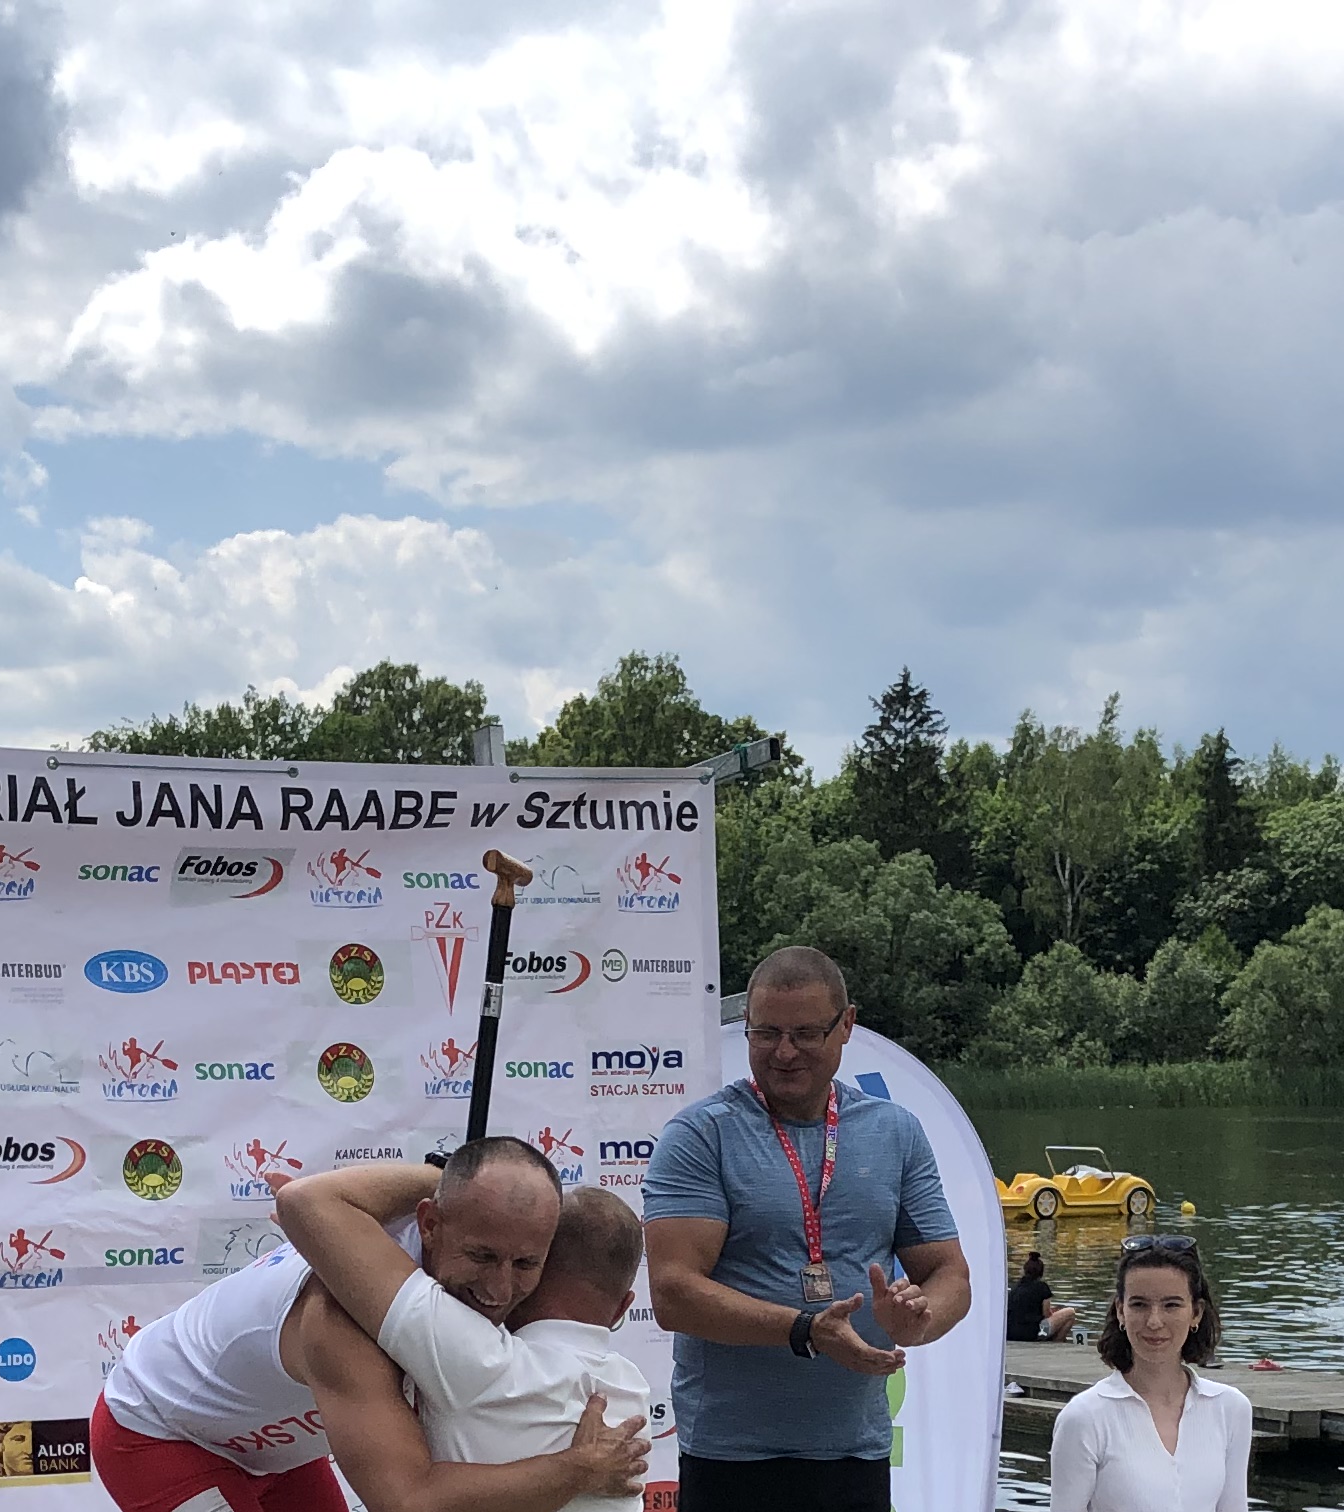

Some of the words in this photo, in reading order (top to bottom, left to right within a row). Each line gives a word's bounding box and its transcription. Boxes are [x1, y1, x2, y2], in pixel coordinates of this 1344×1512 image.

[116, 780, 264, 831] JANA
[280, 787, 458, 831] RAABE
[470, 804, 510, 828] w
[516, 790, 700, 832] Sztumie
[78, 864, 160, 883] sonac
[178, 856, 259, 877] Fobos
[402, 871, 480, 890] sonac
[424, 901, 465, 929] PZK
[338, 946, 373, 962] LZS
[98, 961, 155, 983] KBS
[326, 1045, 361, 1061] LZS
[592, 1043, 682, 1081] moya
[194, 1061, 275, 1081] sonac
[506, 1060, 574, 1079] sonac
[590, 1084, 639, 1097] STACJA
[641, 1084, 685, 1095] SZTUM
[133, 1142, 172, 1157] LZS
[335, 1147, 403, 1160] KANCELARIA
[105, 1247, 184, 1266] sonac
[38, 1443, 86, 1458] ALIOR
[39, 1458, 79, 1471] BANK
